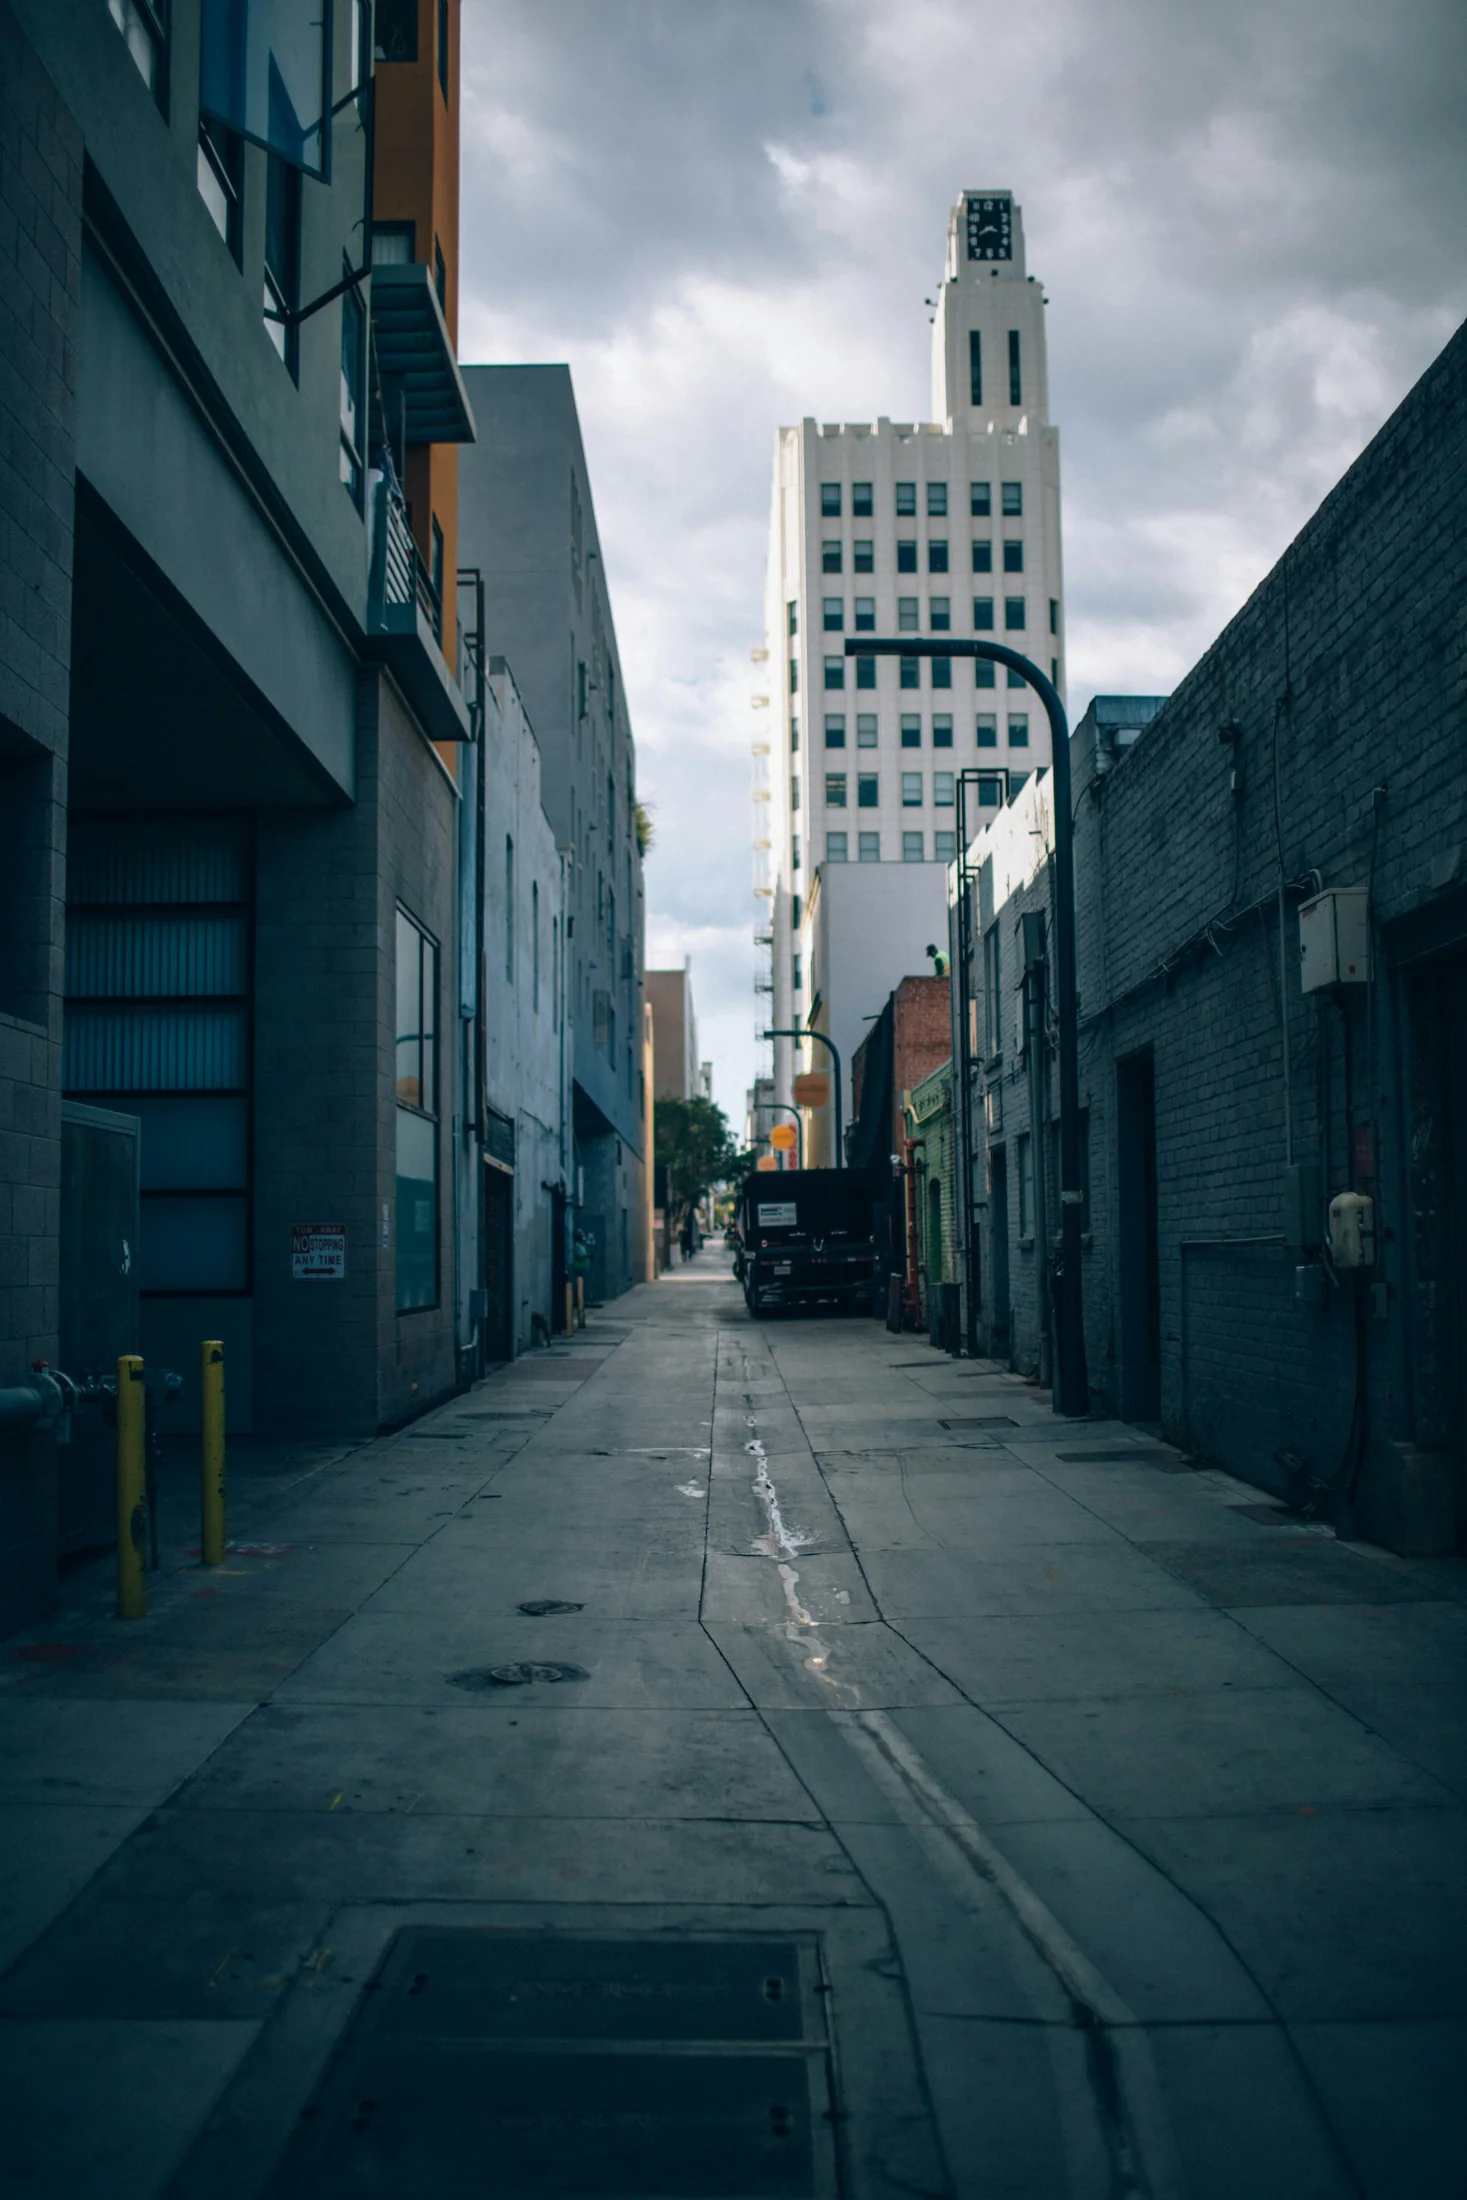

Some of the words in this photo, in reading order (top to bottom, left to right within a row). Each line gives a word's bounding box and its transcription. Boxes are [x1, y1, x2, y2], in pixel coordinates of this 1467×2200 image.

[983, 200, 993, 210] 12
[1001, 212, 1008, 222] 2
[1001, 224, 1009, 234] 3
[1001, 237, 1008, 246] 4
[974, 248, 981, 258] 7
[986, 248, 994, 258] 6
[999, 248, 1006, 258] 5
[293, 1235, 309, 1251] NO
[295, 1255, 315, 1265] ANY
[319, 1255, 342, 1265] TIME
